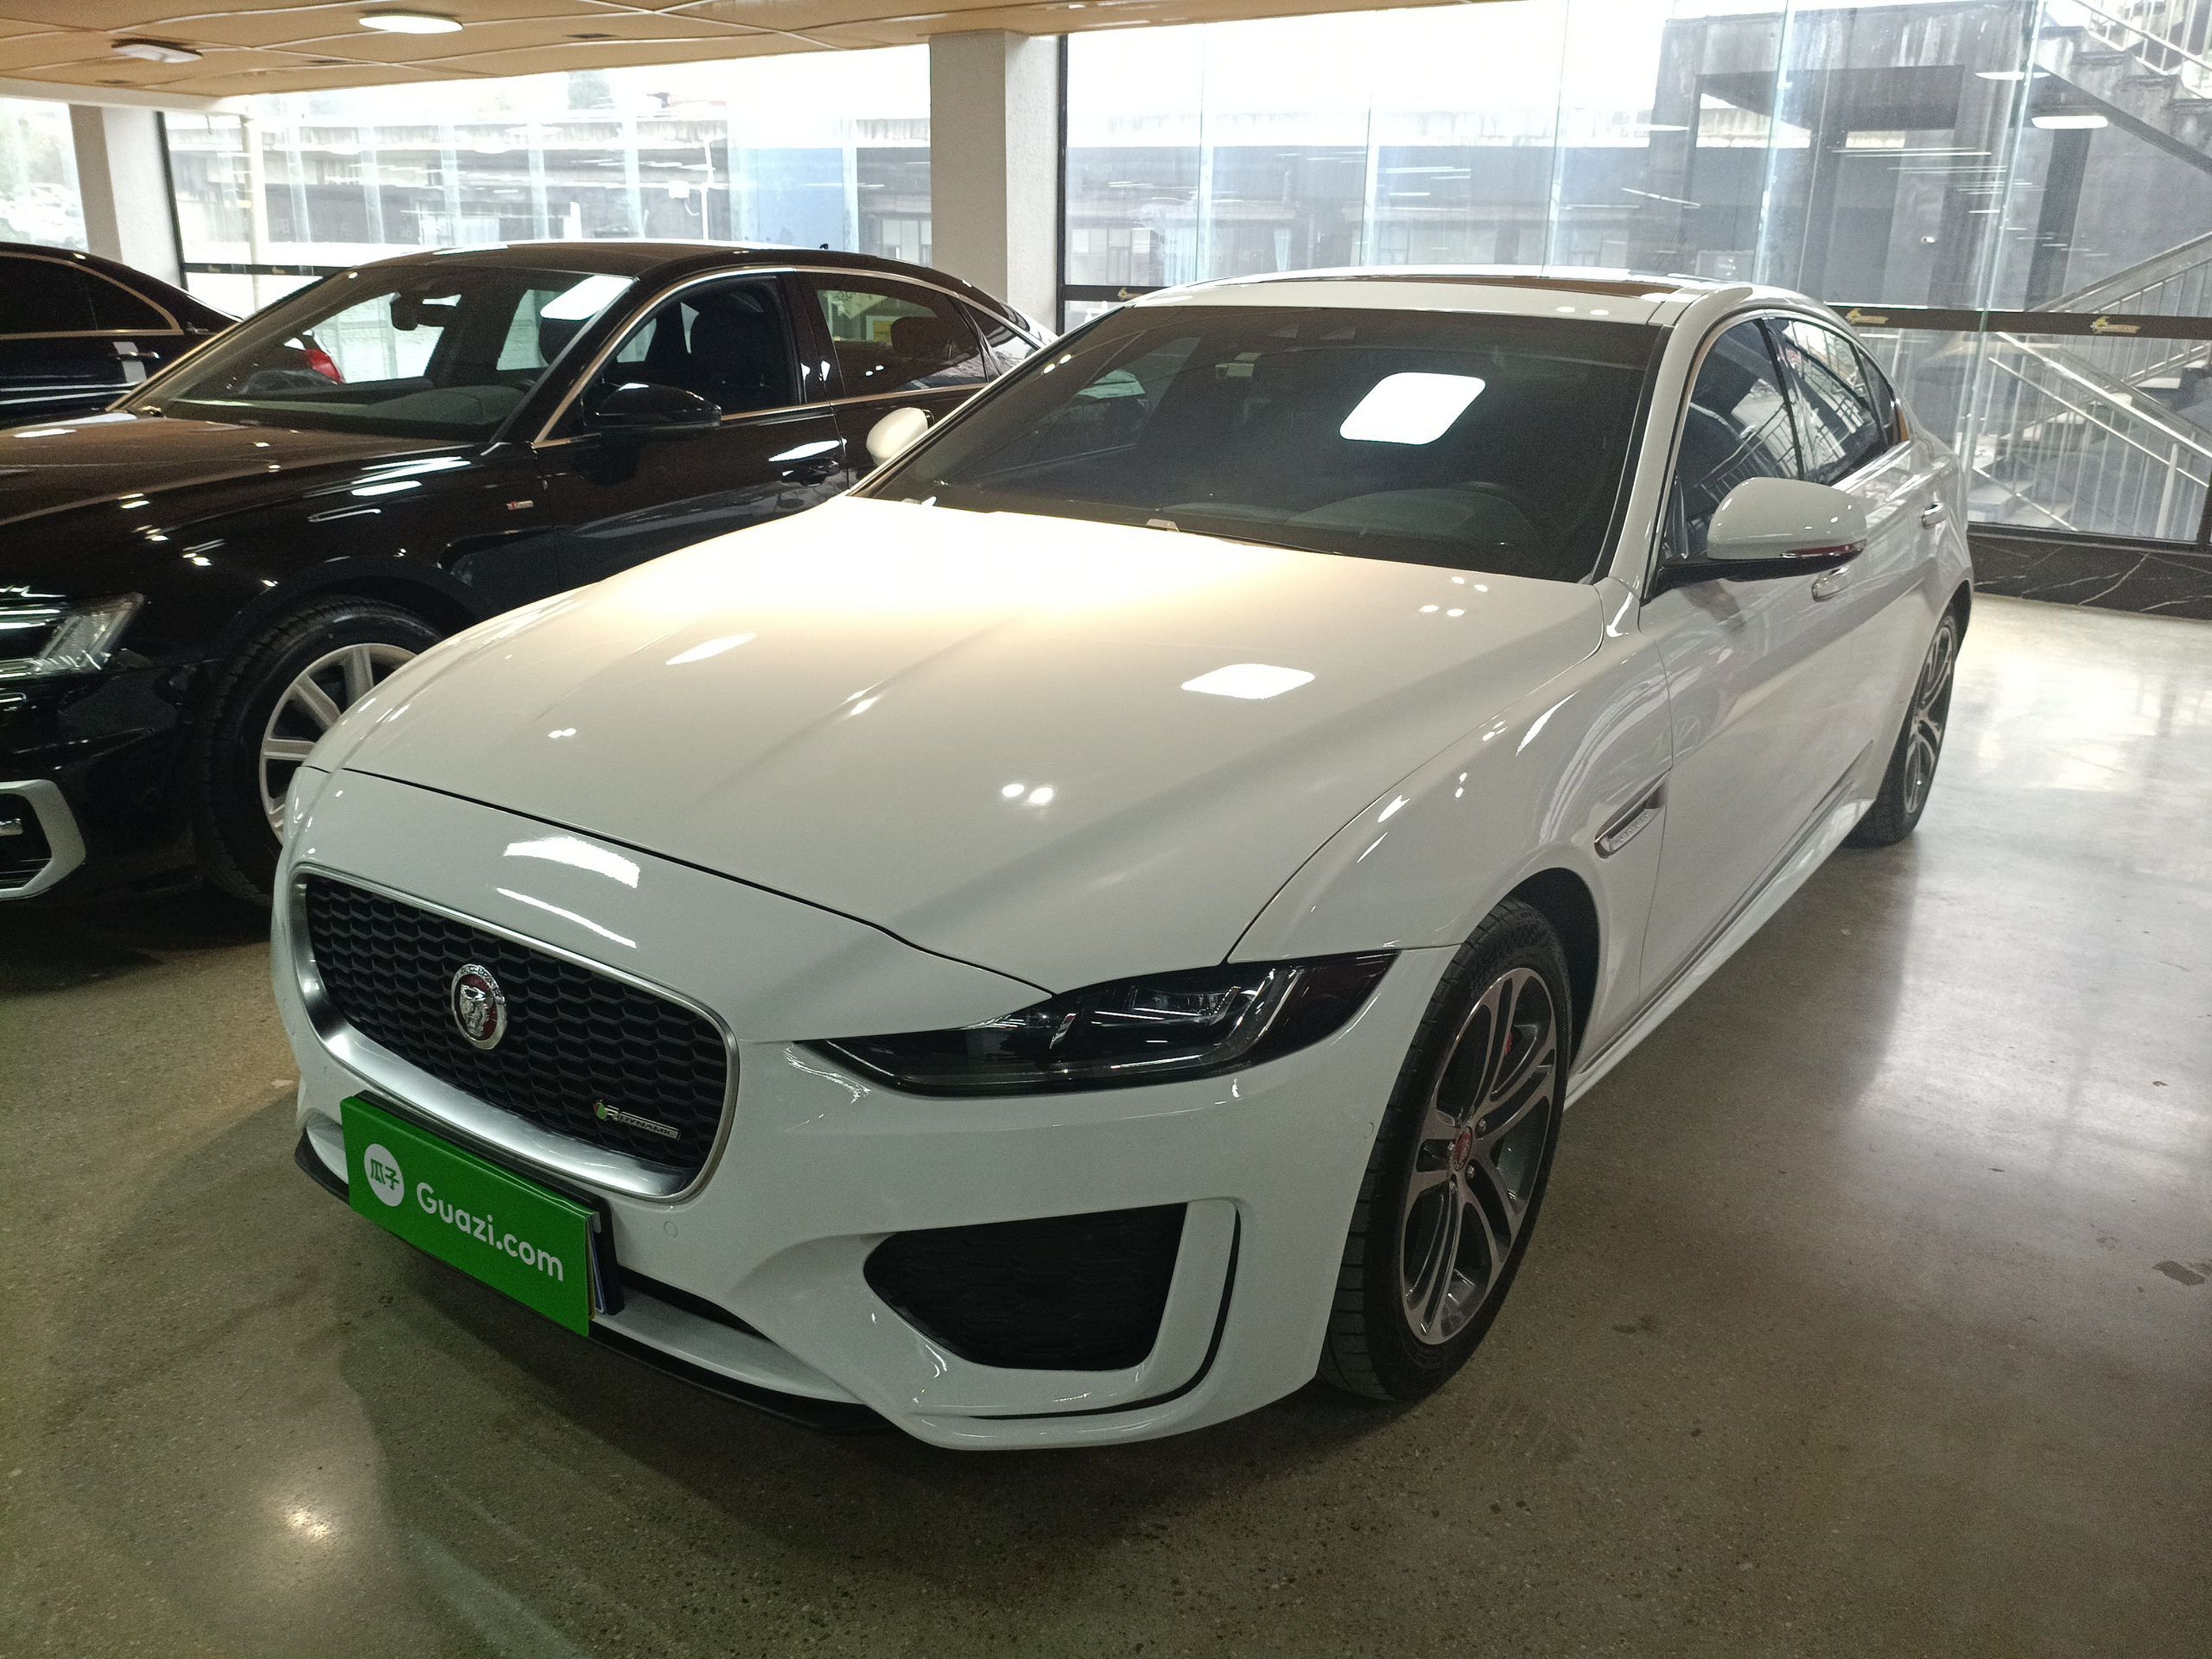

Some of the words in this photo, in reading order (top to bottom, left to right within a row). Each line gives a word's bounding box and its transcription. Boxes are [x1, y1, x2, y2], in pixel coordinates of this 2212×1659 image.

[620, 1115, 677, 1138] DYNAMIC
[370, 1158, 400, 1191] 瓜子
[416, 1181, 564, 1282] Guazi.com
